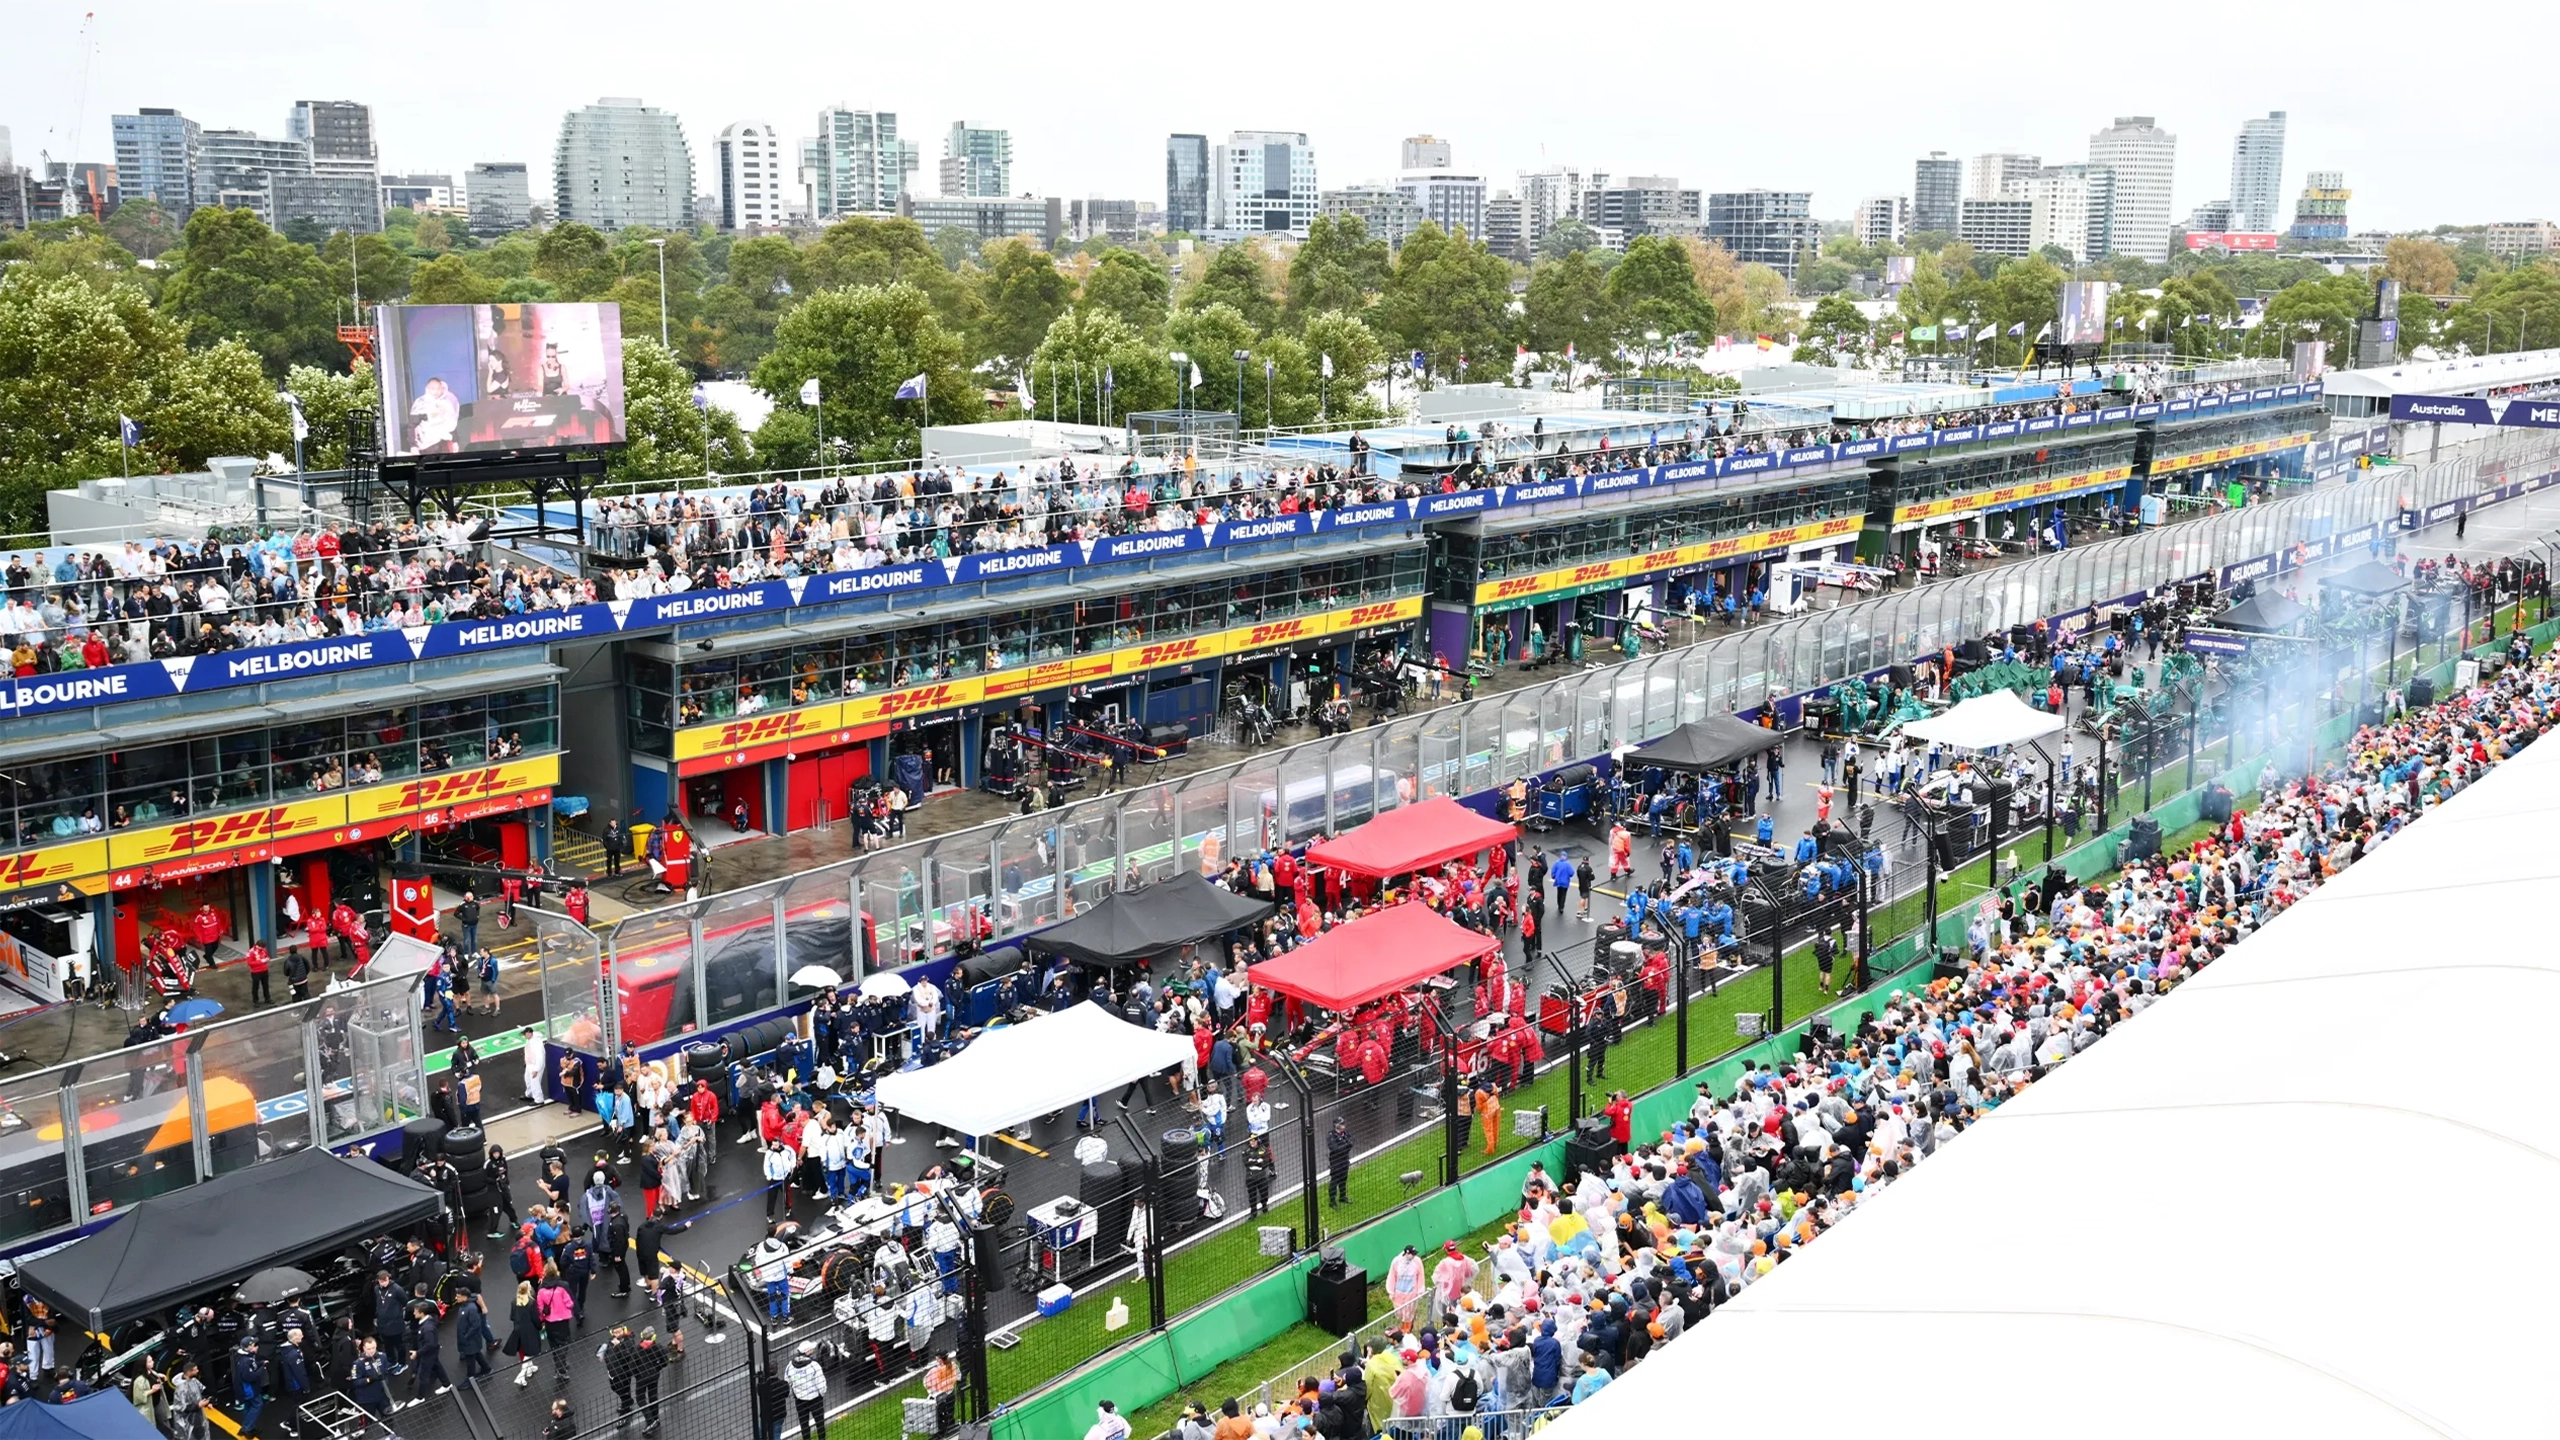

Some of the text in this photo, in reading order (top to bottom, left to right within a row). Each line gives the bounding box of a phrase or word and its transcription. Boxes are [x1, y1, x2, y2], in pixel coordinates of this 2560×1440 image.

[2138, 404, 2160, 415] MELBOURNE
[2170, 400, 2190, 410] MELBOURNE
[2409, 403, 2466, 416] Australia
[2068, 413, 2092, 424] MELBOURNE
[2103, 409, 2127, 419] MELBOURNE
[1988, 425, 2015, 436] MELBOURNE
[2029, 419, 2054, 430] MELBOURNE
[1944, 430, 1973, 441] MELBOURNE
[1845, 443, 1878, 455] MELBOURNE
[1896, 437, 1928, 449] MELBOURNE
[2341, 437, 2363, 451] MELBOURNE
[1790, 450, 1825, 462] MELBOURNE
[1730, 457, 1768, 470] MELBOURNE
[1665, 466, 1706, 480] MELBOURNE
[2105, 469, 2122, 481] DHL
[1595, 474, 1638, 489] MELBOURNE
[2033, 482, 2054, 495] DHL
[2071, 475, 2090, 488] DHL
[1516, 484, 1565, 500] MELBOURNE
[1994, 489, 2016, 502] DHL
[1430, 494, 1484, 512] MELBOURNE
[1952, 496, 1975, 510] DHL
[1335, 507, 1395, 526] MELBOURNE
[1907, 504, 1932, 518] DHL
[2430, 503, 2455, 521] MELBOURNE
[2402, 514, 2411, 525] E
[1230, 519, 1296, 540] MELBOURNE
[1822, 519, 1850, 535] DHL
[1768, 529, 1798, 545] DHL
[2341, 527, 2372, 548] MELBOURNE
[1112, 534, 1185, 556] MELBOURNE
[1709, 538, 1740, 555] DHL
[1644, 551, 1680, 568] DHL
[2289, 543, 2323, 564] MOURNE
[980, 550, 1061, 574] MELBOURNE
[1575, 563, 1612, 582] DHL
[2230, 559, 2268, 583] MELBOURNE
[829, 569, 922, 595] MELBOURNE
[1498, 577, 1539, 597] DHL
[657, 590, 764, 620] MELBOURNE
[612, 609, 628, 617] MEL
[1350, 602, 1400, 625] DHL
[459, 614, 583, 646] MELBOURNE
[1250, 620, 1303, 644] DHL
[408, 636, 426, 644] MEL
[2189, 639, 2215, 648] LOUIS
[1139, 639, 1199, 665] DHL
[228, 642, 373, 679] MELBOURNE
[168, 668, 189, 677] MEL
[1036, 663, 1067, 675] DHL
[1003, 681, 1025, 690] FASTEST
[1088, 681, 1130, 693] VERSTAPPEN
[878, 685, 957, 714] DHL
[920, 715, 954, 727] LAWSON
[720, 713, 807, 745] DHL
[399, 768, 508, 808] DHL
[464, 804, 510, 818] LECLERC
[424, 812, 439, 825] 16
[169, 808, 294, 852] DHL
[161, 861, 226, 878] HAMILTON
[115, 874, 131, 887] 44
[1468, 1049, 1488, 1073] 16
